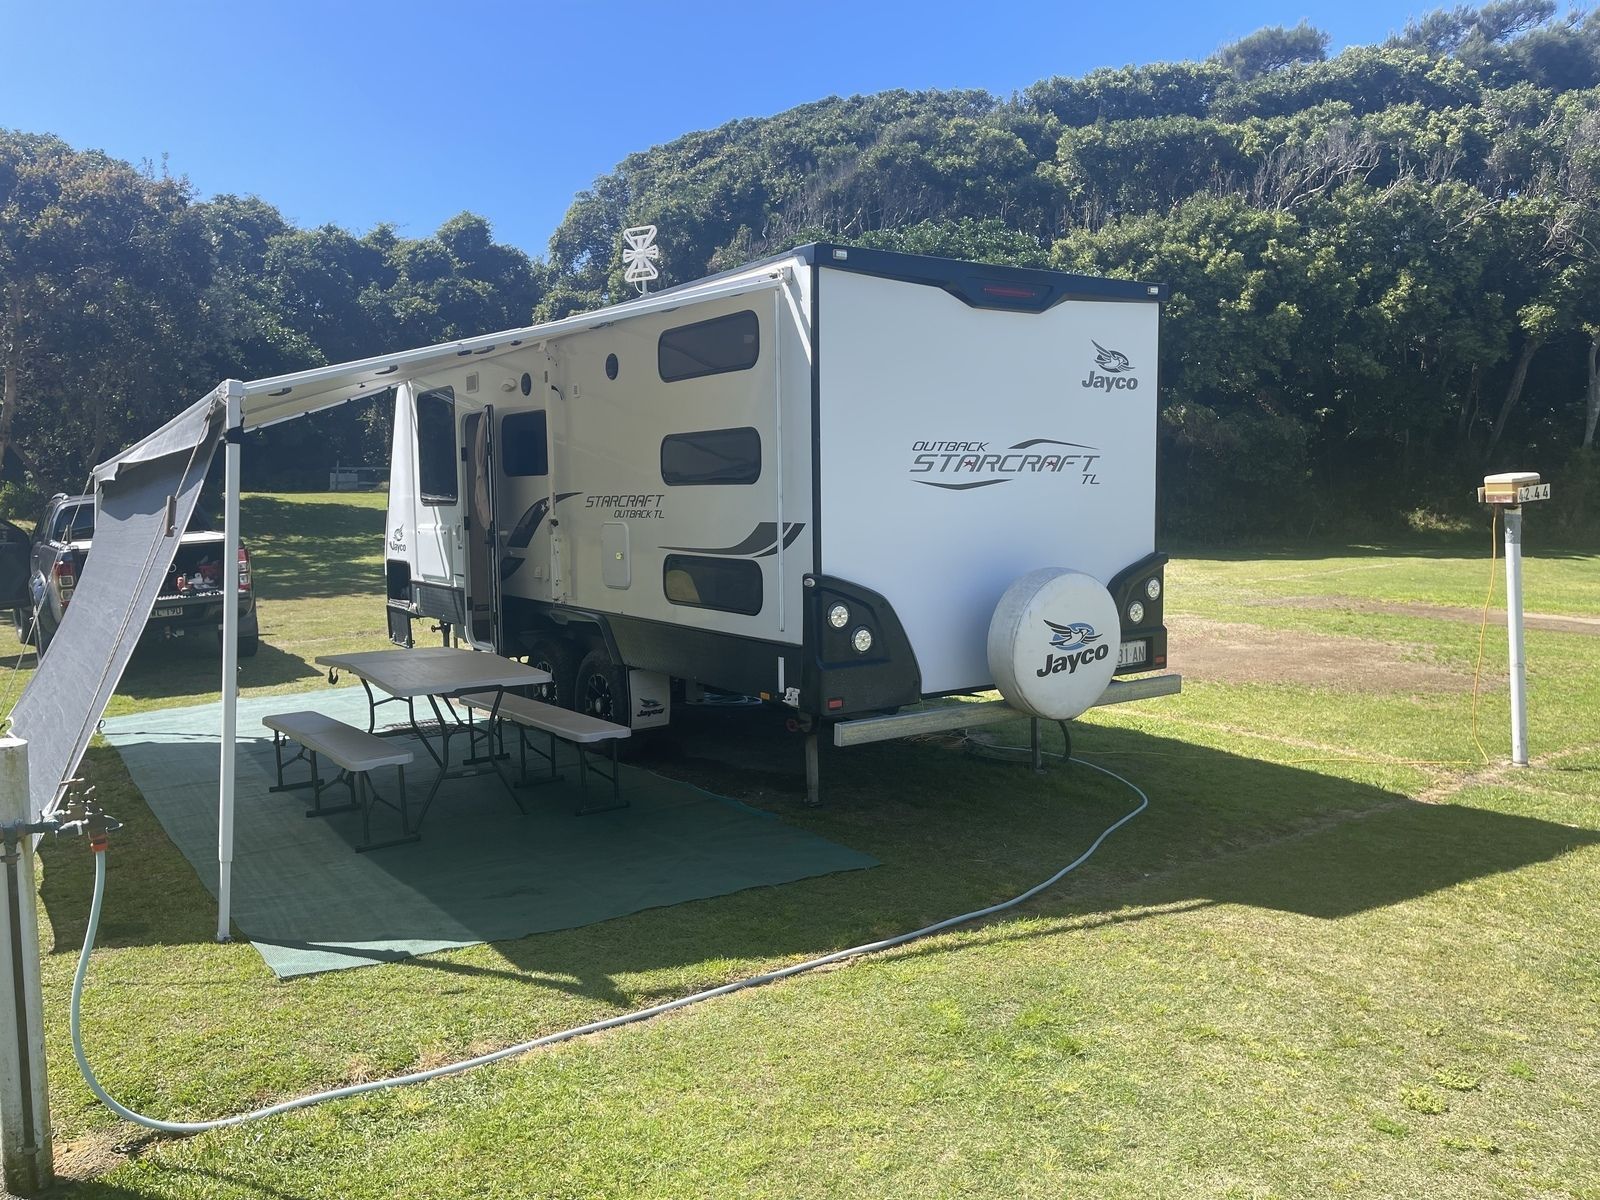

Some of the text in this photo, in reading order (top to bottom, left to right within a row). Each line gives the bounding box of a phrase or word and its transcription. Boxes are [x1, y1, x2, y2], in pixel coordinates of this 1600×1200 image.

[1082, 371, 1138, 393] Jayco
[912, 441, 989, 452] OUTBACK
[909, 454, 1101, 473] STARCRAFT
[1082, 474, 1101, 485] TL
[585, 494, 665, 508] STARCRAFT
[613, 509, 665, 519] OUTBACK TL
[389, 541, 407, 554] Jayco
[1036, 644, 1109, 677] Jayco
[636, 707, 665, 718] Jayco
